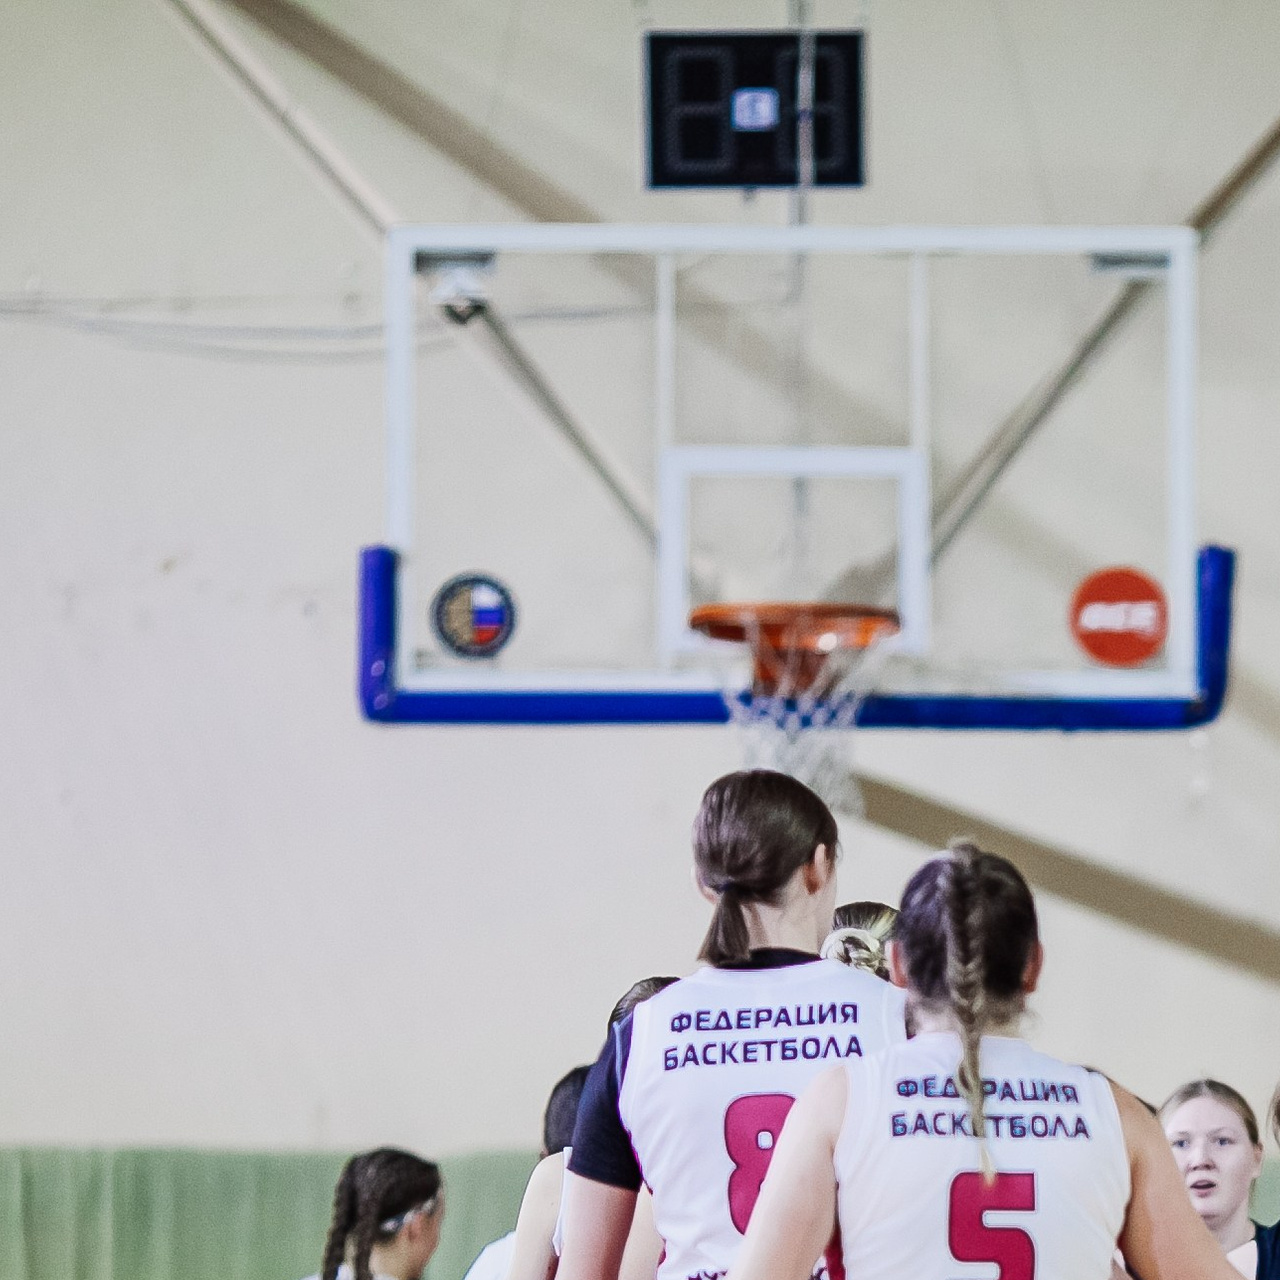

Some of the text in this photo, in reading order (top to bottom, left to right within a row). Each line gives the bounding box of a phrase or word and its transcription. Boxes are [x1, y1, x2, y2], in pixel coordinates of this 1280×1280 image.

[671, 1003, 859, 1033] ФЕДЕРАЦИЯ
[664, 1036, 863, 1071] БАСКЕТБОЛА
[896, 1075, 1079, 1103] ФЕДРАЦИЯ
[891, 1112, 1090, 1139] БАСКТБОЛА
